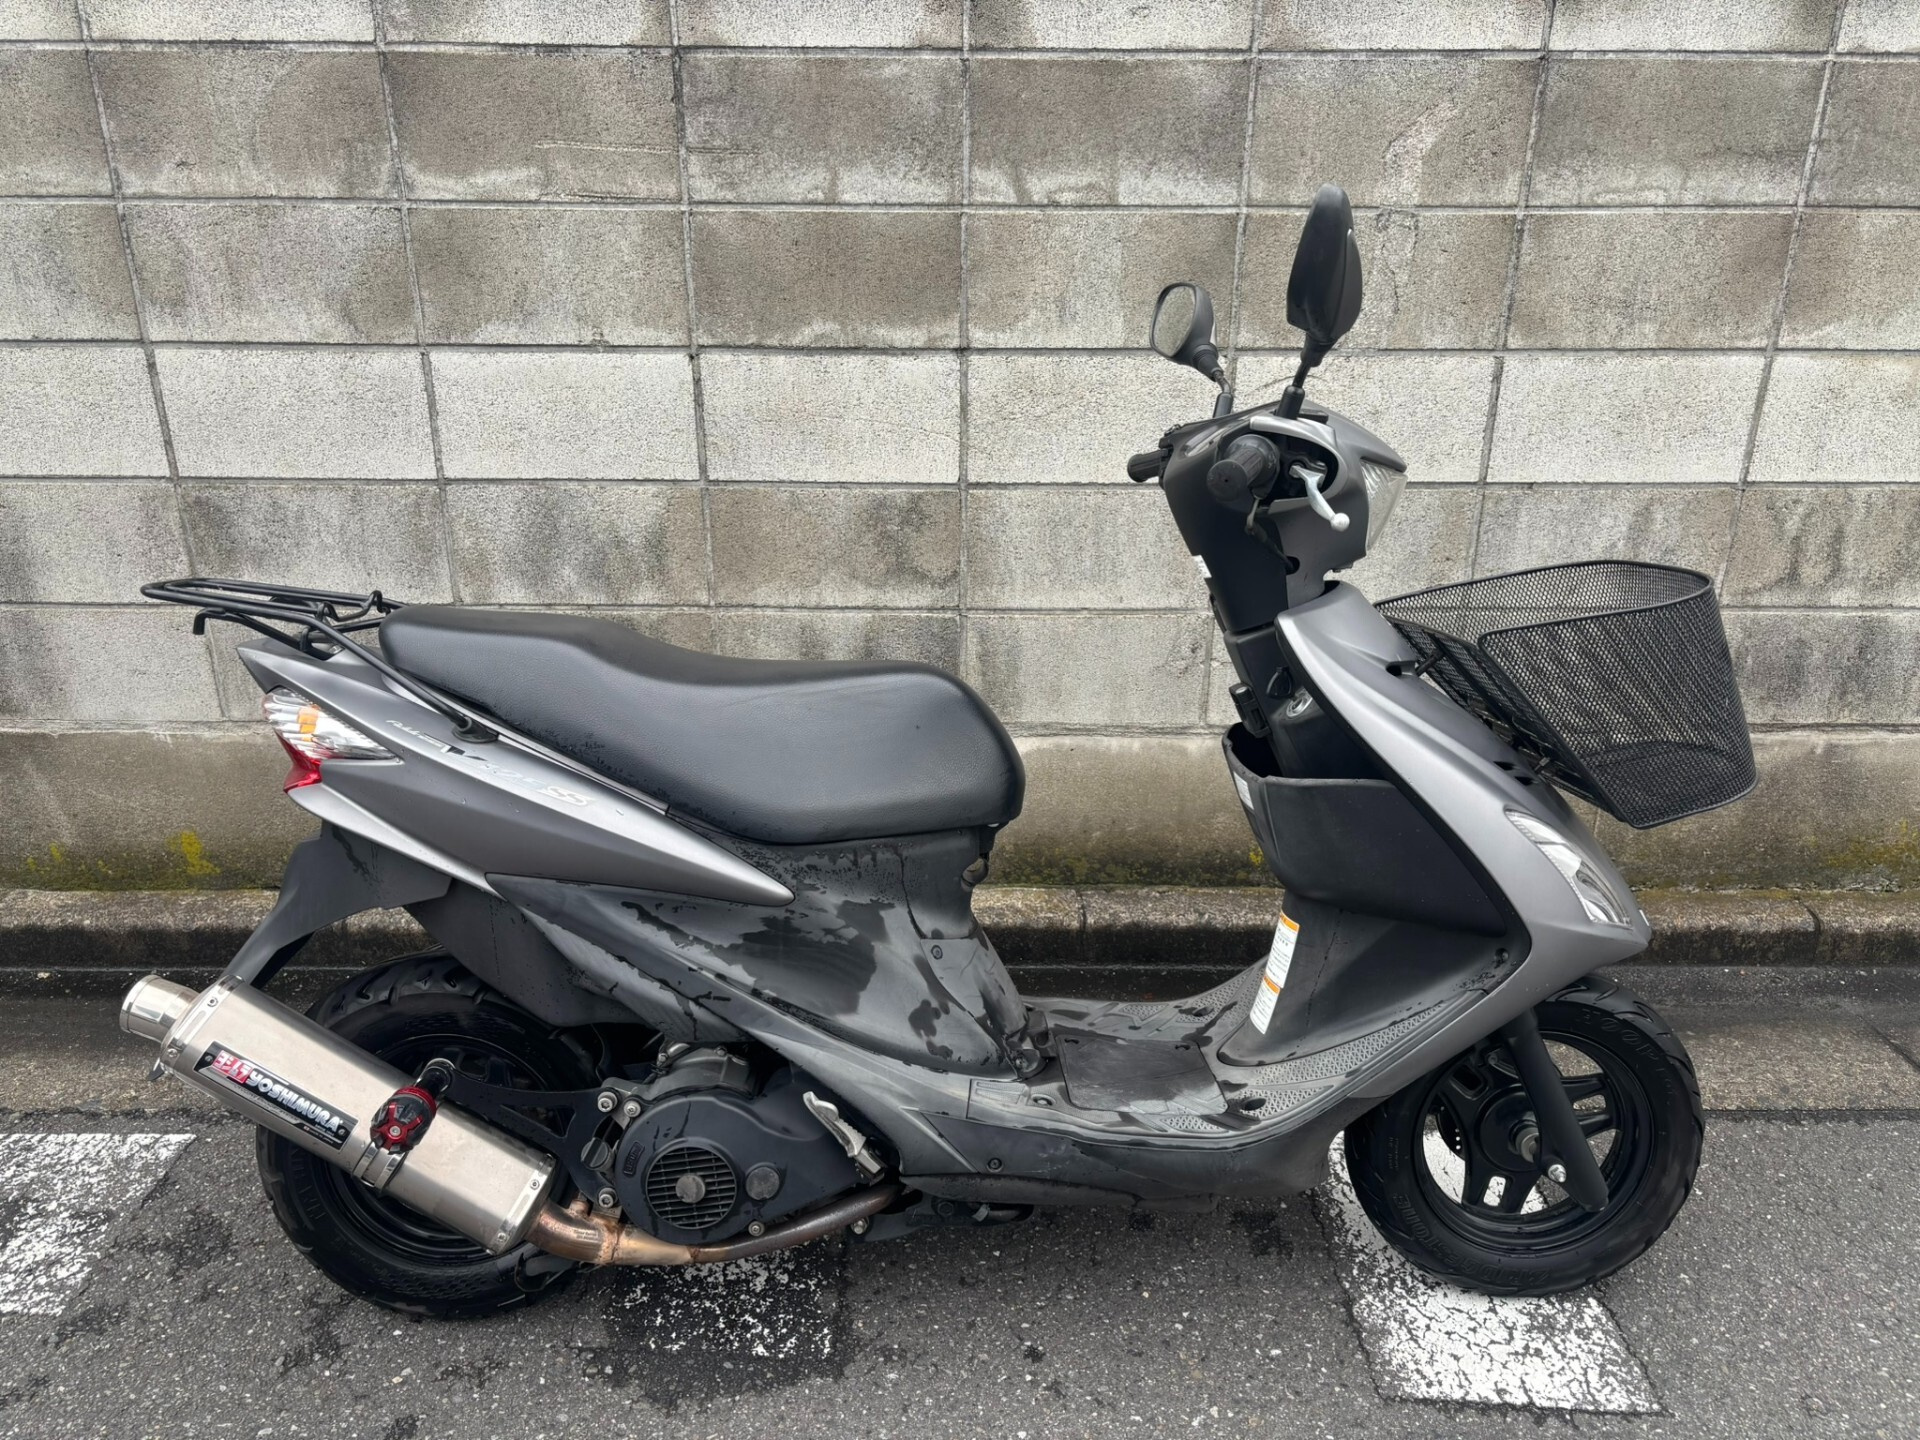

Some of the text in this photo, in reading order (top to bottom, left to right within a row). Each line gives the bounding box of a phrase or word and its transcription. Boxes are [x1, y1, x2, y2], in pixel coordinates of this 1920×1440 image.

[386, 720, 443, 747] Addr
[213, 1051, 252, 1081] ヨシムラ
[247, 1069, 340, 1132] YOSHIMURA
